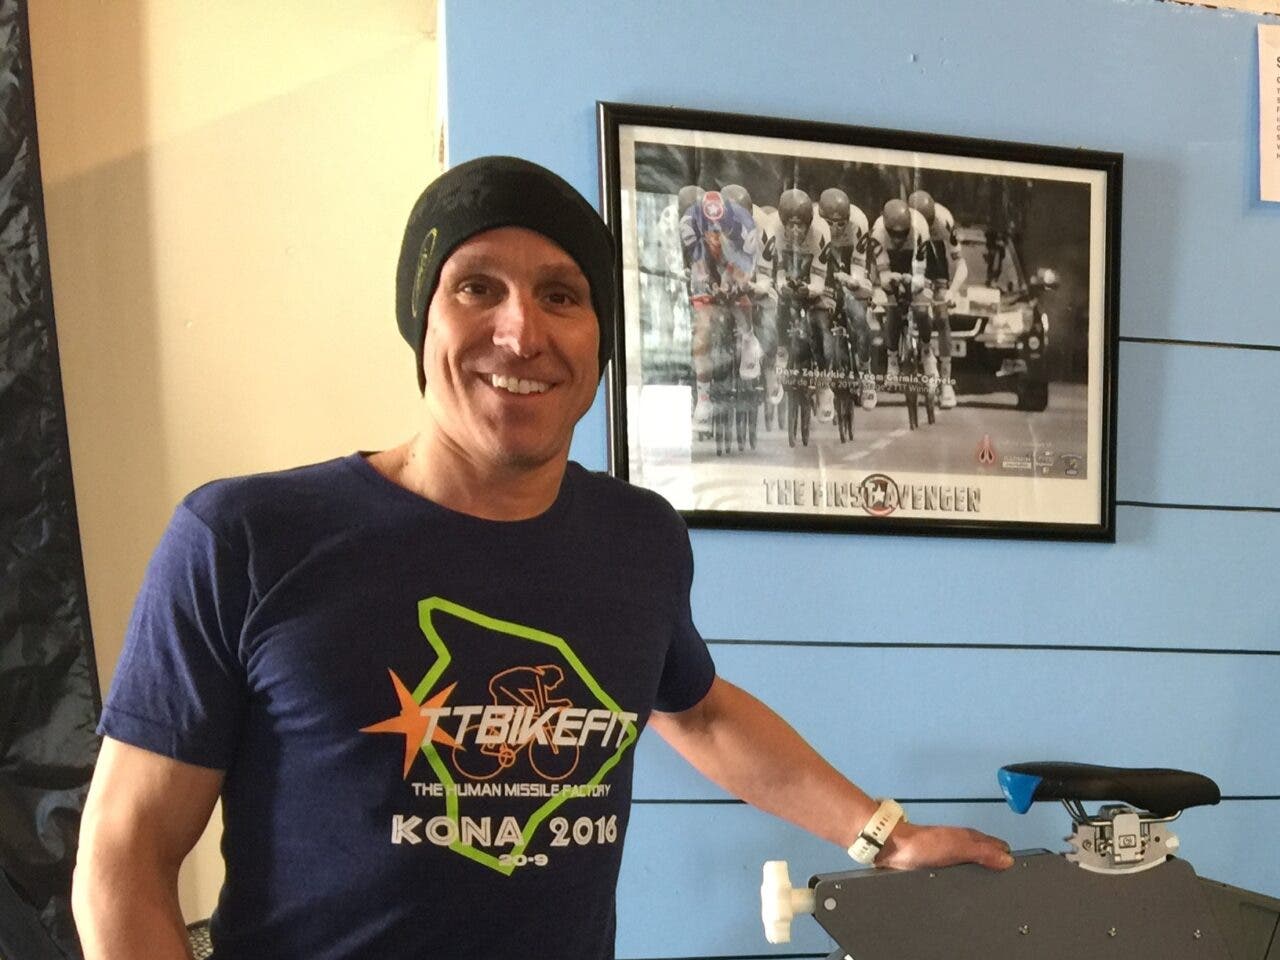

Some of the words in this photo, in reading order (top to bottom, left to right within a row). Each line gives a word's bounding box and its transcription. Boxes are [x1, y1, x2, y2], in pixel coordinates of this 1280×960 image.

[763, 478, 805, 506] THE
[419, 704, 638, 748] TTBIKEFIT
[411, 782, 444, 797] THE
[445, 783, 502, 798] HUMAN
[504, 783, 560, 798] MISSILE
[561, 783, 612, 798] FACTORY
[390, 813, 525, 848] KONA
[548, 814, 618, 848] 2016
